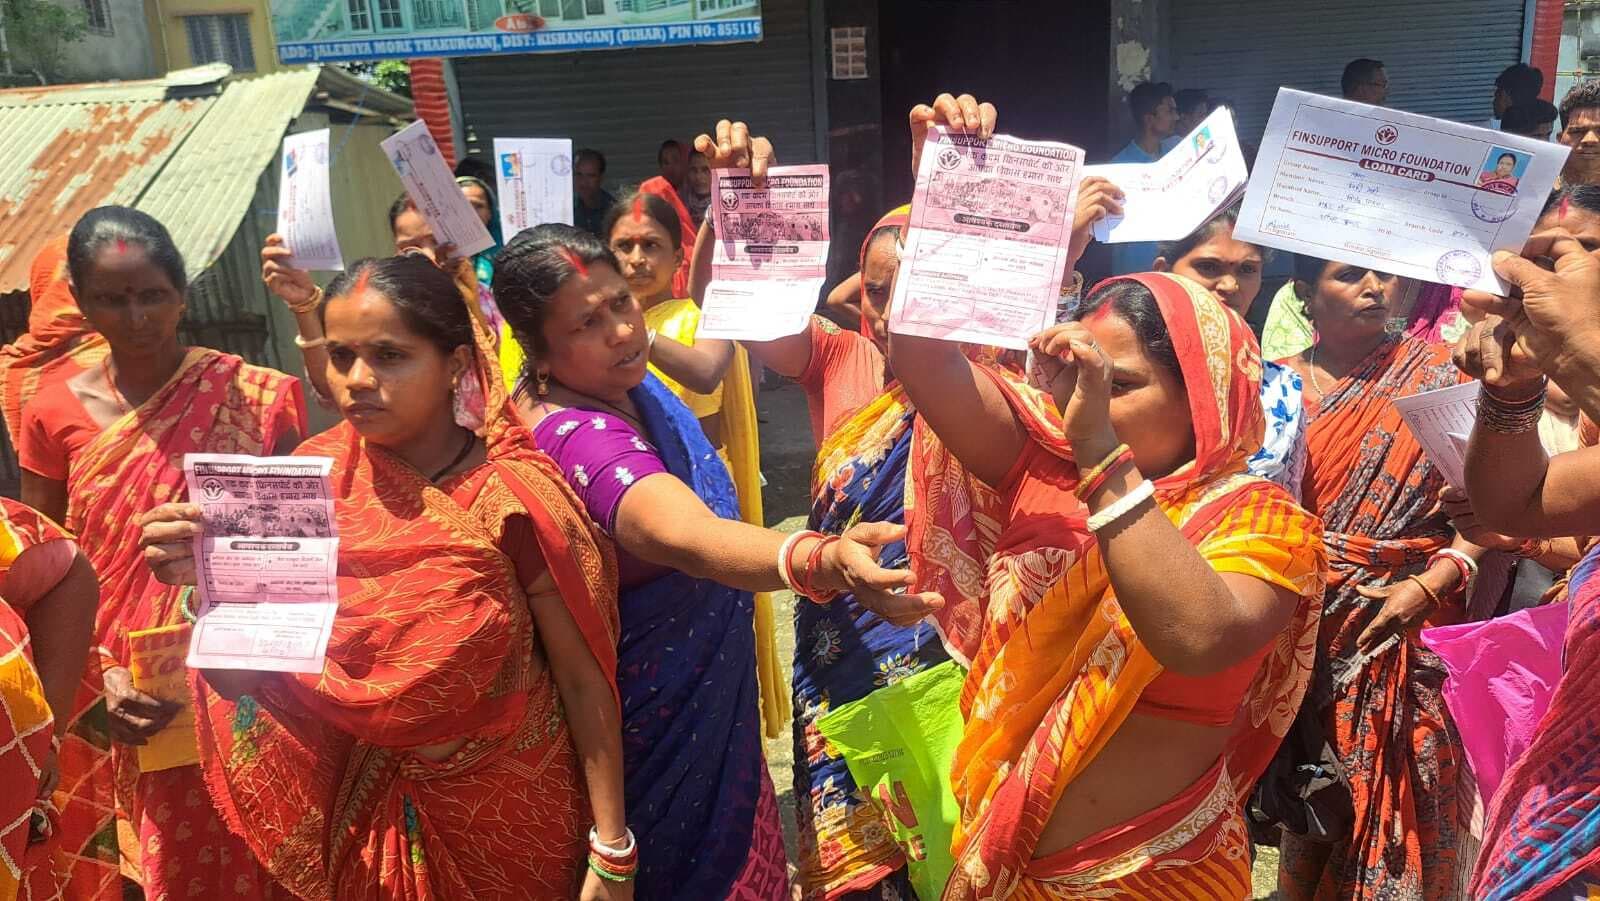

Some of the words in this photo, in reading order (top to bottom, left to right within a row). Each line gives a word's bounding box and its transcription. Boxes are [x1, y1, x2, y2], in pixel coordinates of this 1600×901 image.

[279, 46, 312, 58] ADD:
[374, 40, 412, 53] MORE
[415, 35, 502, 51] THAKURGANJ,
[503, 33, 535, 47] DIST:
[537, 29, 615, 46] KISHANGANJ
[617, 25, 667, 45] (BIHAR)
[669, 25, 691, 39] PIN
[693, 23, 716, 37] NO:
[717, 21, 760, 36] 855116
[1021, 144, 1076, 160] FOUNDATION
[1292, 130, 1360, 153] FINSUPPORT
[1361, 144, 1396, 161] MICRO
[1400, 152, 1471, 177] FOUNDATION
[1364, 160, 1395, 175] LOAN
[1397, 167, 1429, 181] CARD
[782, 176, 823, 187] FOUNDATION
